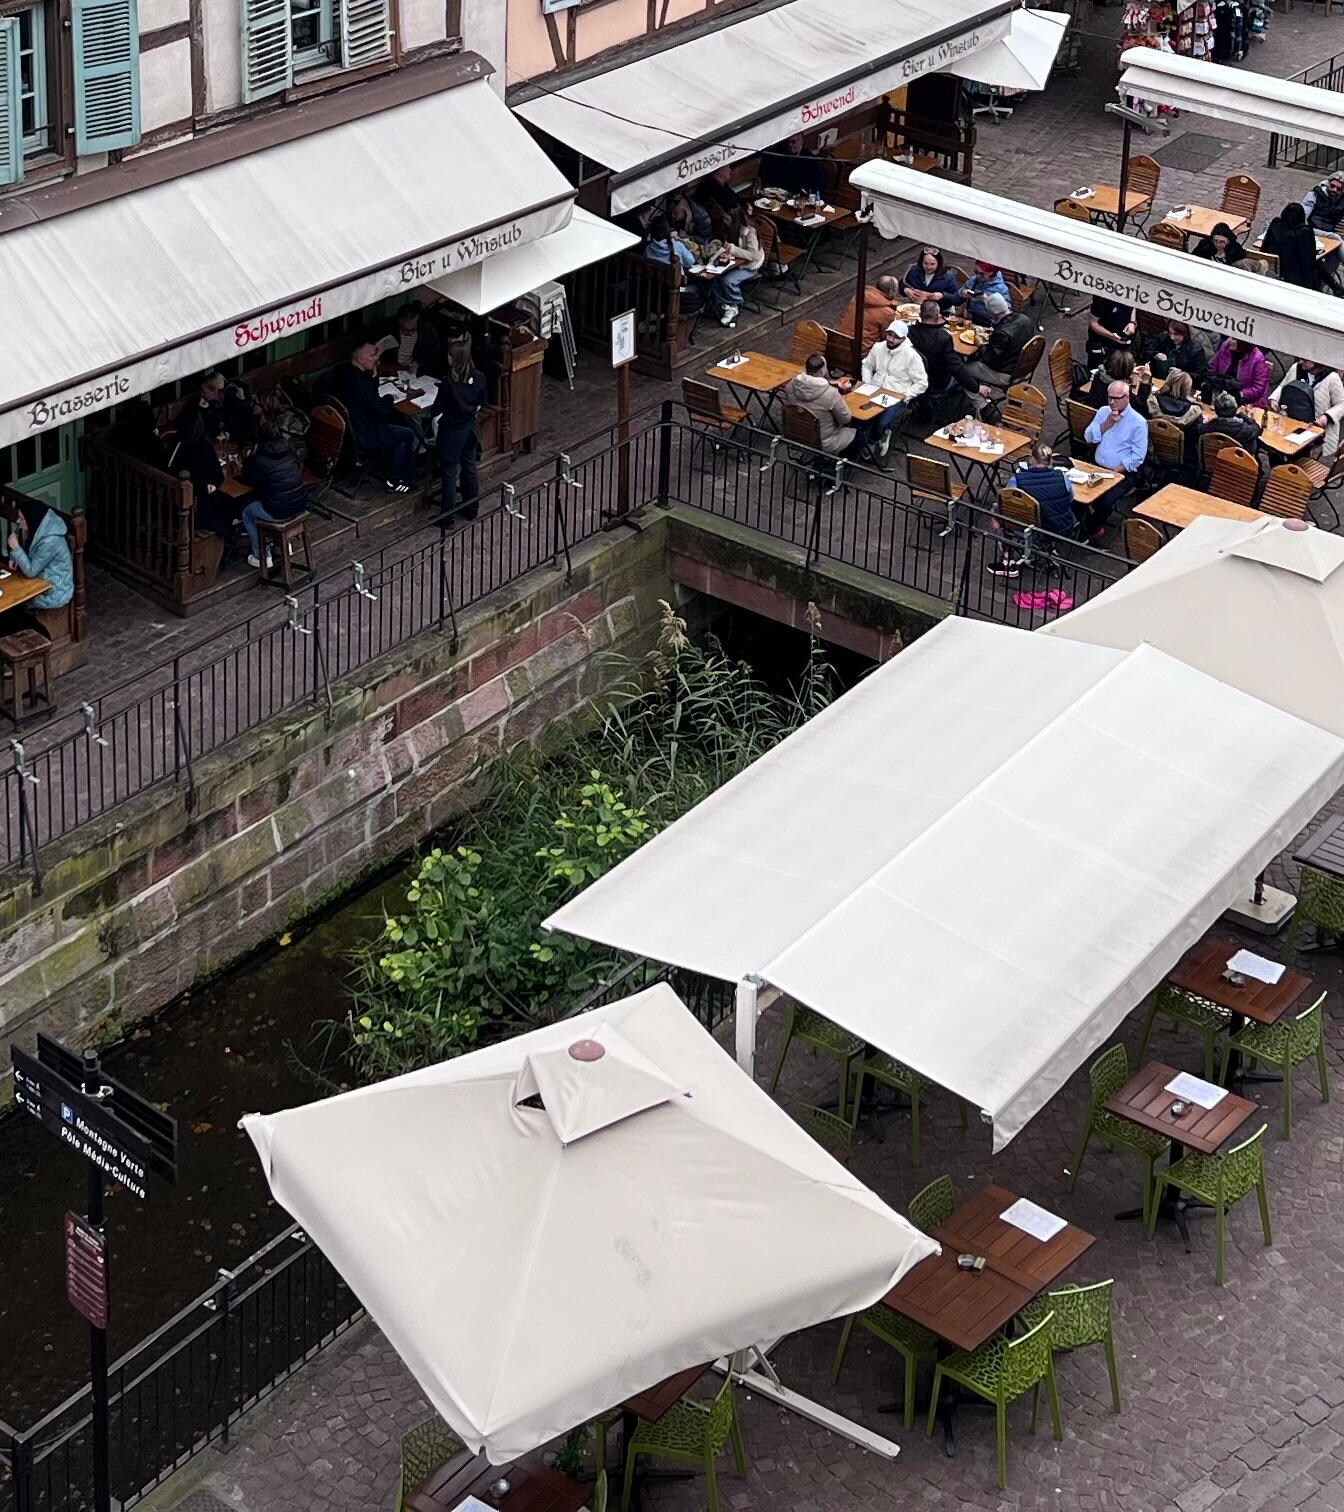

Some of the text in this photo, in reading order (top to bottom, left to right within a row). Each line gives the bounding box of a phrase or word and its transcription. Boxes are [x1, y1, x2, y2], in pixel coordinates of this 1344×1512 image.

[676, 32, 980, 179] Brasserie Schwendi Bier u Winstub
[27, 223, 522, 428] Brasserie Schwendi Bier u Winstub
[1054, 259, 1256, 338] Brasserie Schwendi
[61, 1126, 81, 1149] Pôle
[75, 1116, 118, 1158] Montagne
[120, 1151, 145, 1178] Verte
